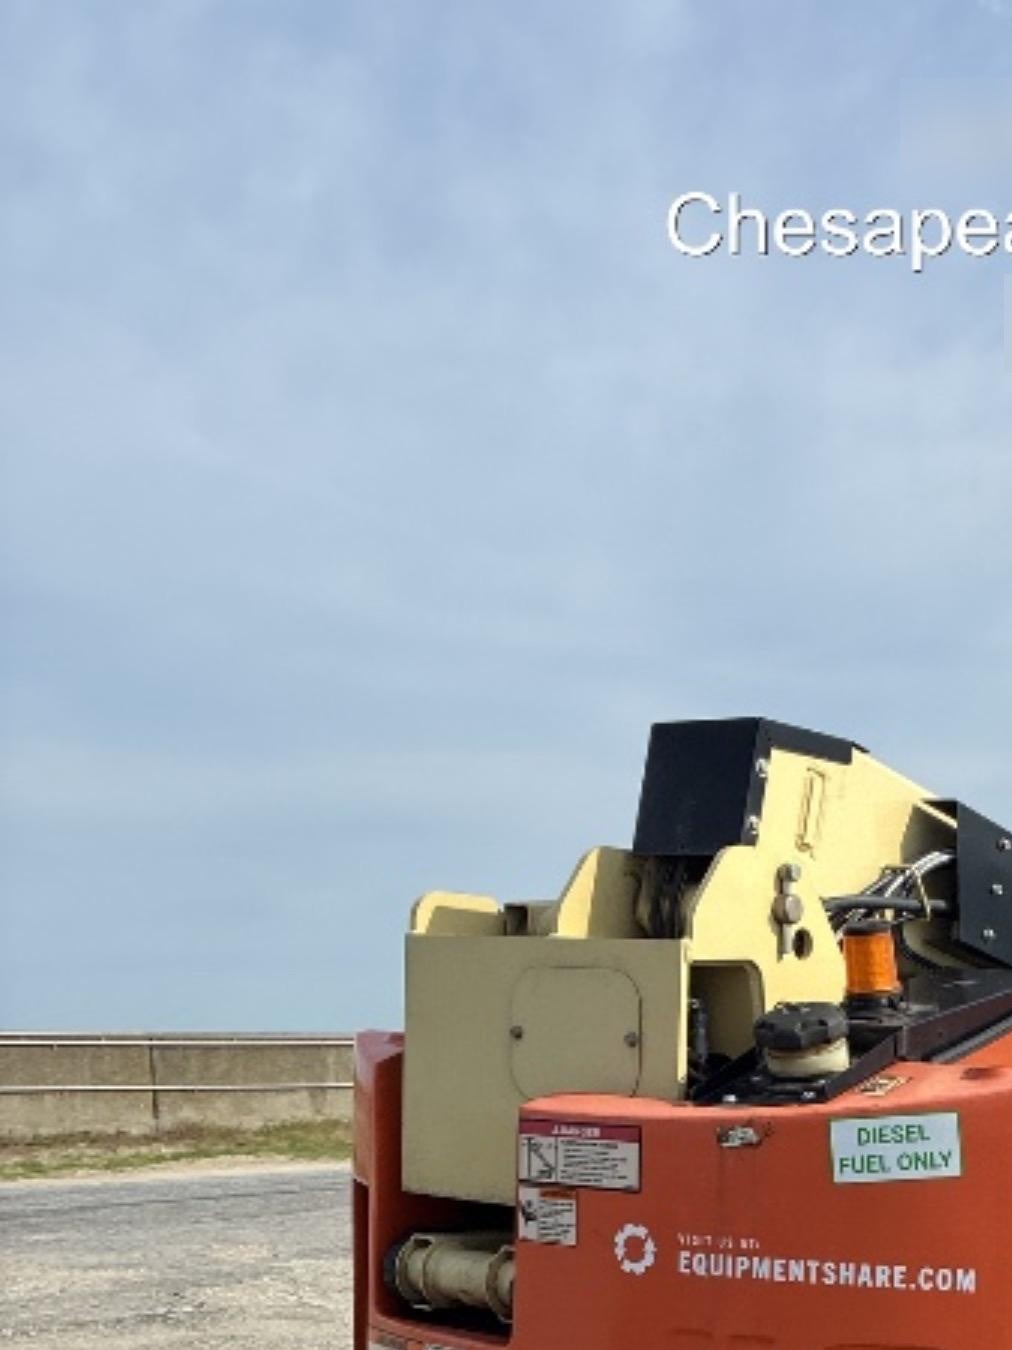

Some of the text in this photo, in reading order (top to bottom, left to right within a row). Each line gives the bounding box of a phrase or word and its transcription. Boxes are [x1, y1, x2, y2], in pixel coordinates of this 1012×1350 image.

[856, 1124, 931, 1147] DIESEL
[838, 1150, 952, 1175] FUEL ONLY
[677, 1249, 977, 1294] EQUIPMENTSHARE.COM
